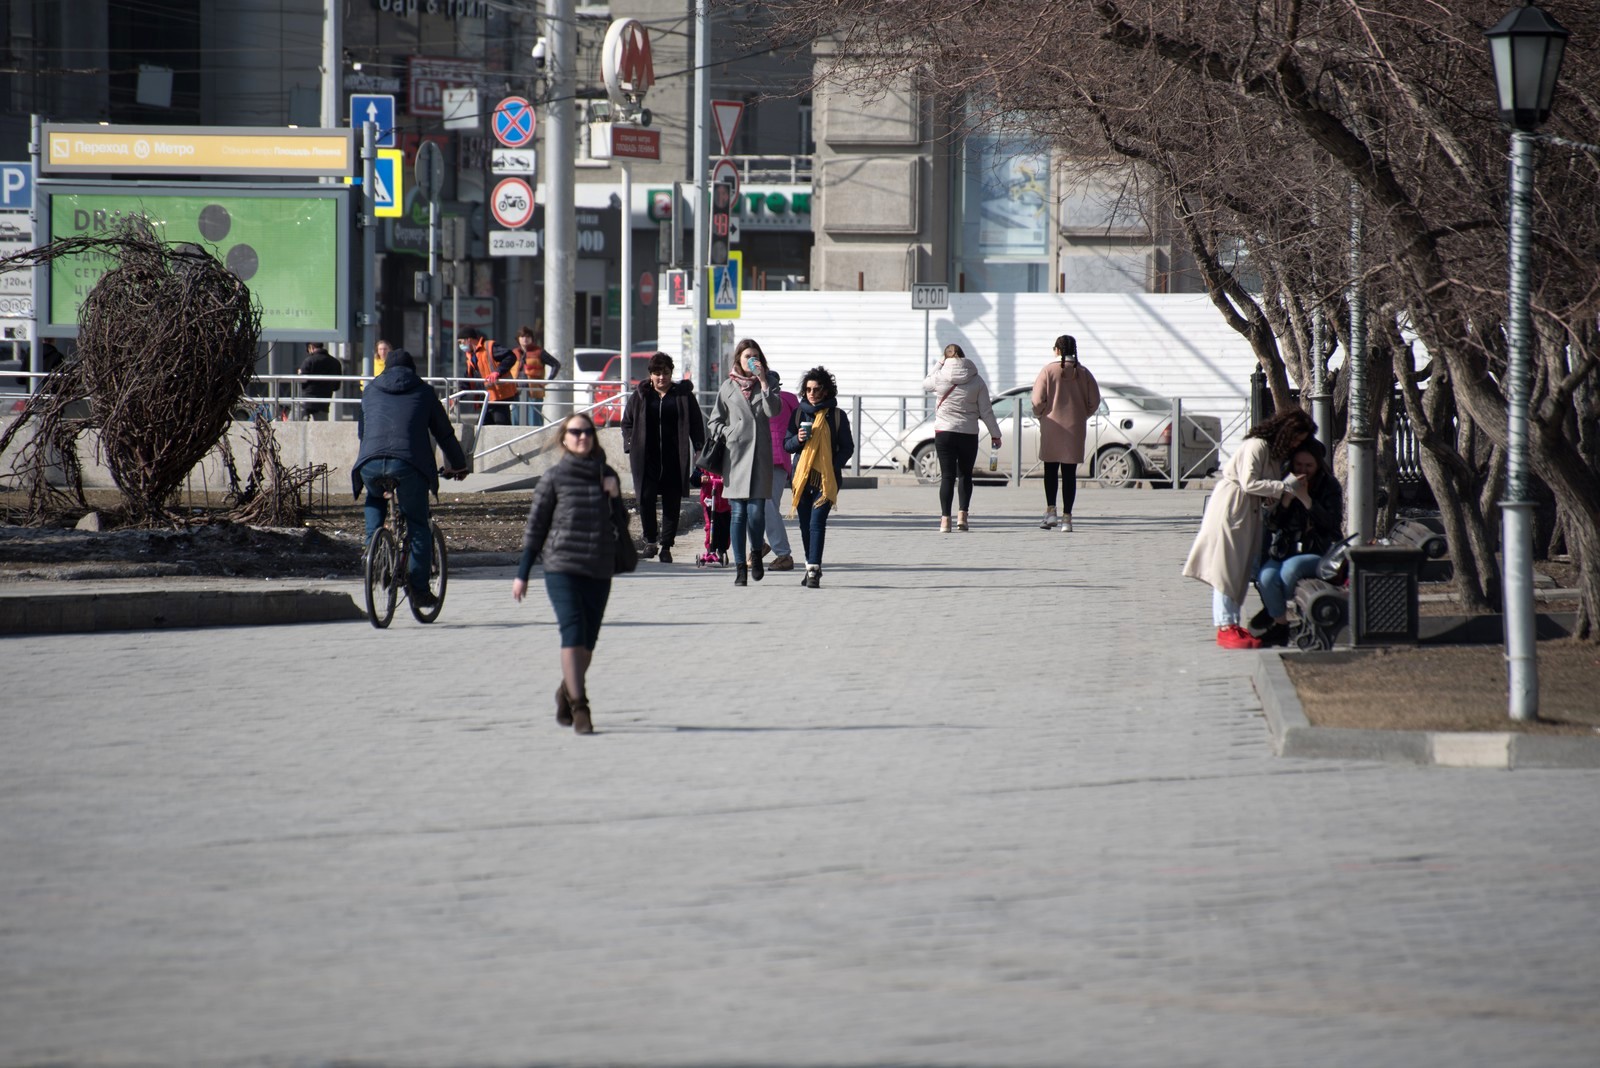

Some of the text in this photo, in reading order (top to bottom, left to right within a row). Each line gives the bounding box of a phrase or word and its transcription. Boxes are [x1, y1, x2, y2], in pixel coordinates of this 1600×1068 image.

[75, 140, 129, 156] Переход
[154, 141, 194, 156] Метро
[3, 168, 26, 204] P
[917, 288, 944, 304] СТОП
